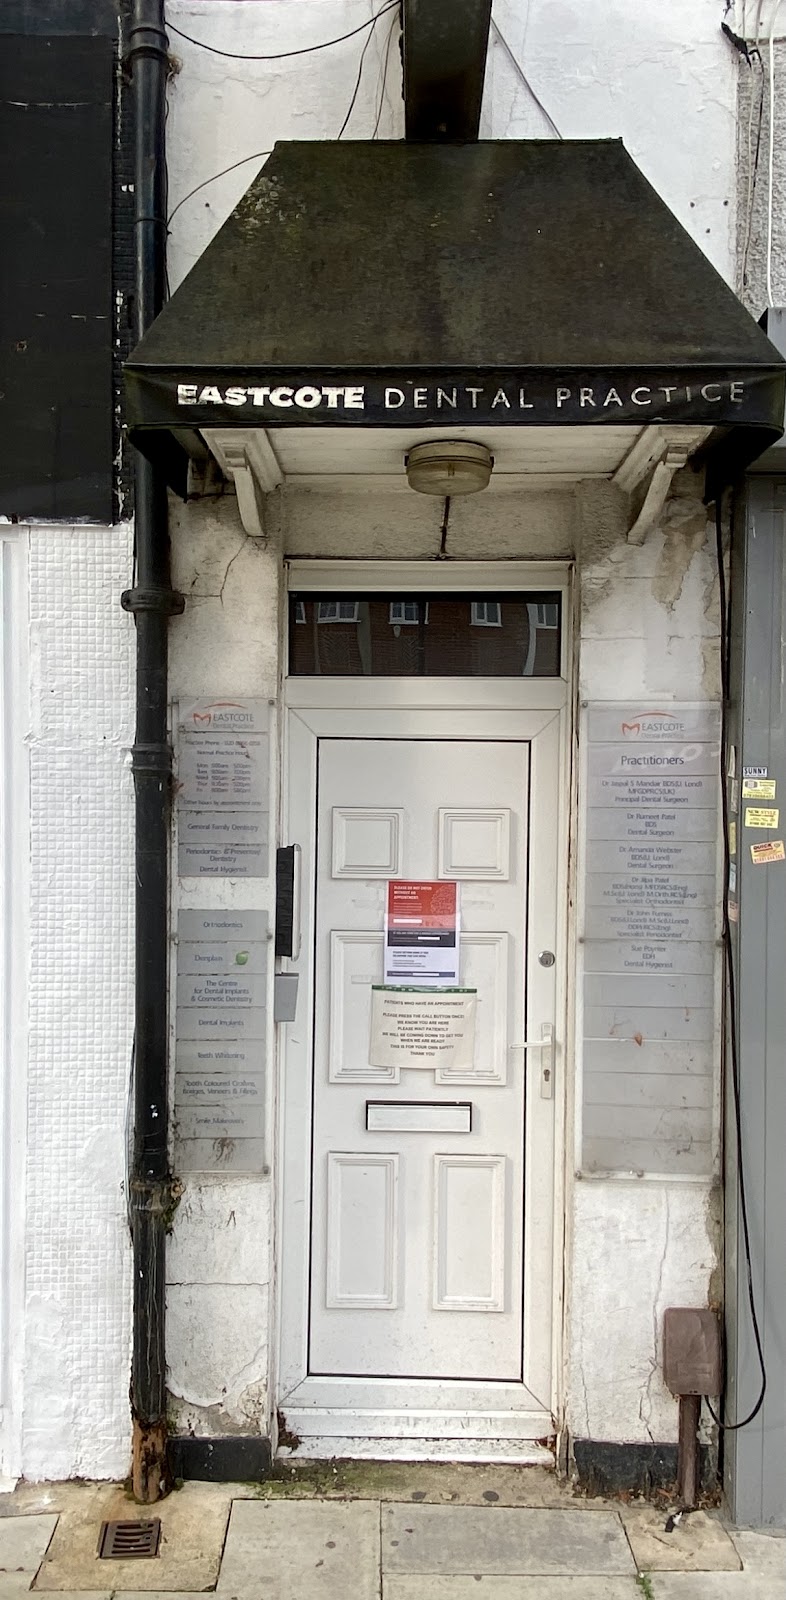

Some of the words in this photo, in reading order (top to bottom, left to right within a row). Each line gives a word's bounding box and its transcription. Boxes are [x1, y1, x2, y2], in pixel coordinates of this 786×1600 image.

[177, 384, 365, 410] EASTCOTE
[385, 387, 534, 410] DENTAL
[557, 380, 745, 408] PRACTICE
[213, 714, 254, 722] EASTCOTE
[641, 723, 685, 732] EASTCOTE
[621, 756, 684, 766] Practitioners
[232, 824, 258, 832] Dentistry
[649, 829, 674, 837] Surgeon
